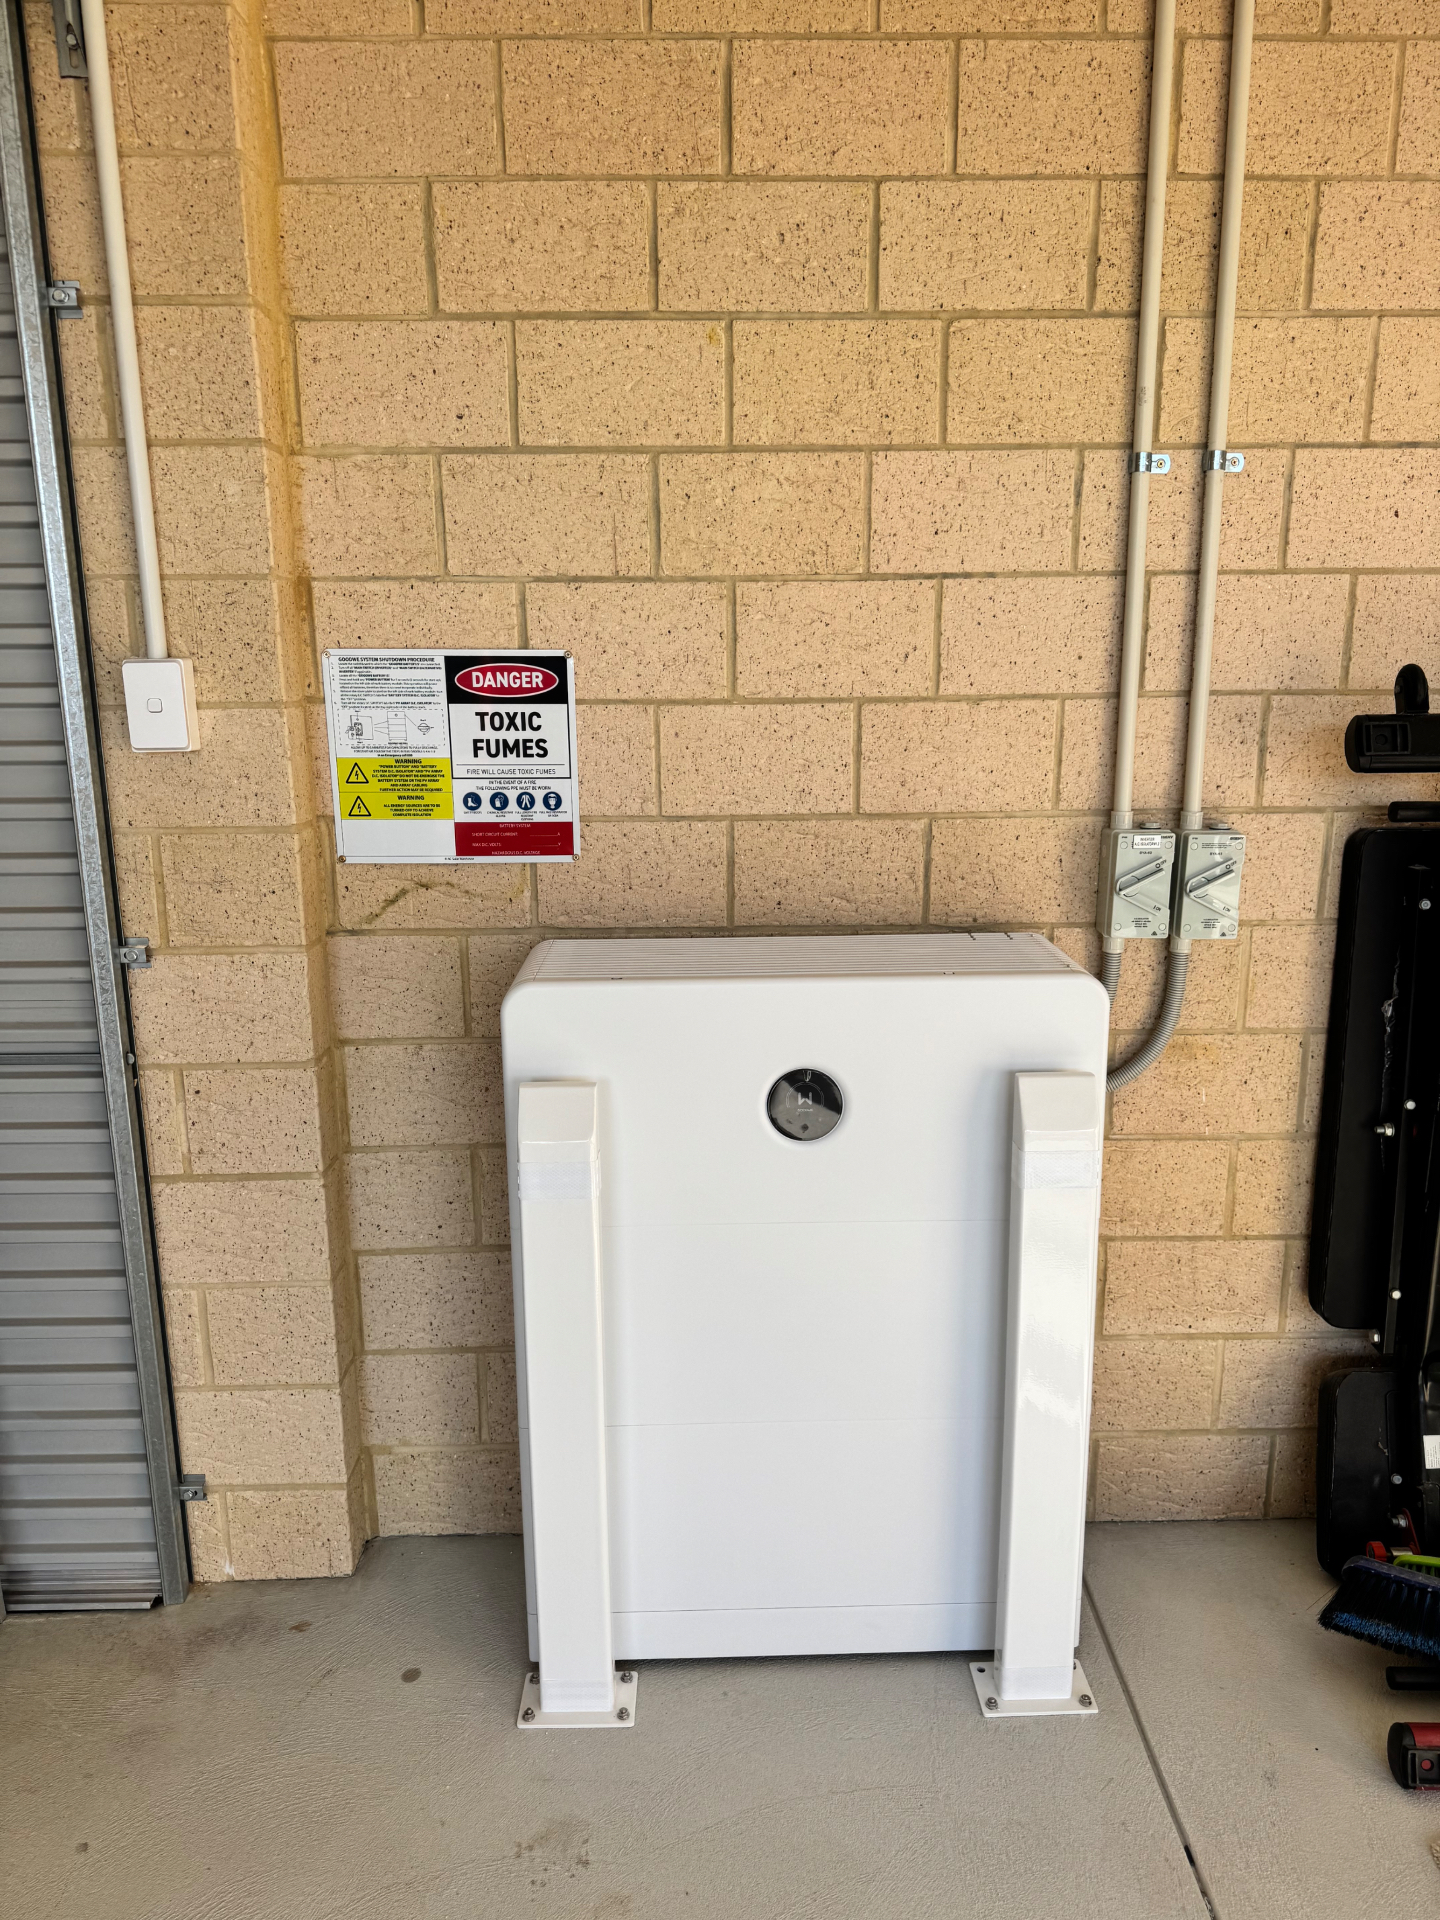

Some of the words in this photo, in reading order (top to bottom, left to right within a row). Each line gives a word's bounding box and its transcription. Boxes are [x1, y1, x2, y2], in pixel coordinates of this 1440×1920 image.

[472, 672, 543, 688] DANGER
[475, 712, 542, 731] TOXIC
[473, 738, 548, 758] FUMES
